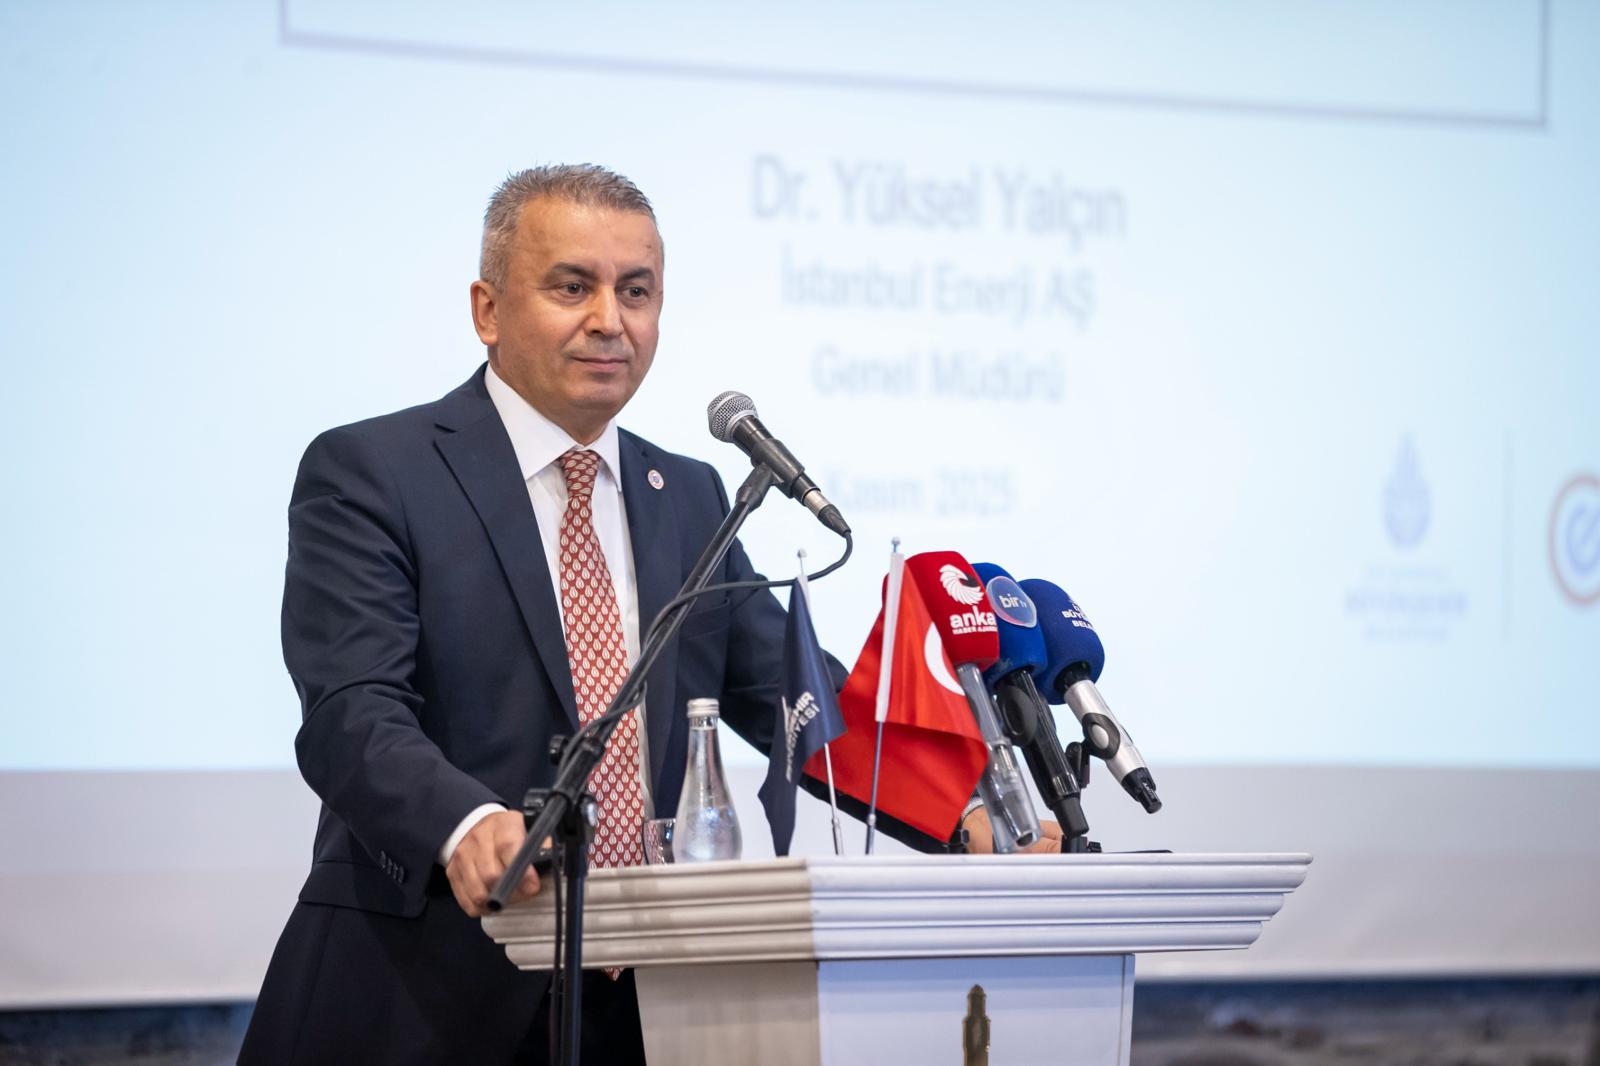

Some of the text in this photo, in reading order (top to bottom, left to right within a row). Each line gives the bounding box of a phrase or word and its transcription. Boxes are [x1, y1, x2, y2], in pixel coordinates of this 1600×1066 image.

[752, 153, 1128, 253] Dr. Yüksel Yalçın
[810, 343, 917, 397] Genel
[950, 605, 997, 628] anka
